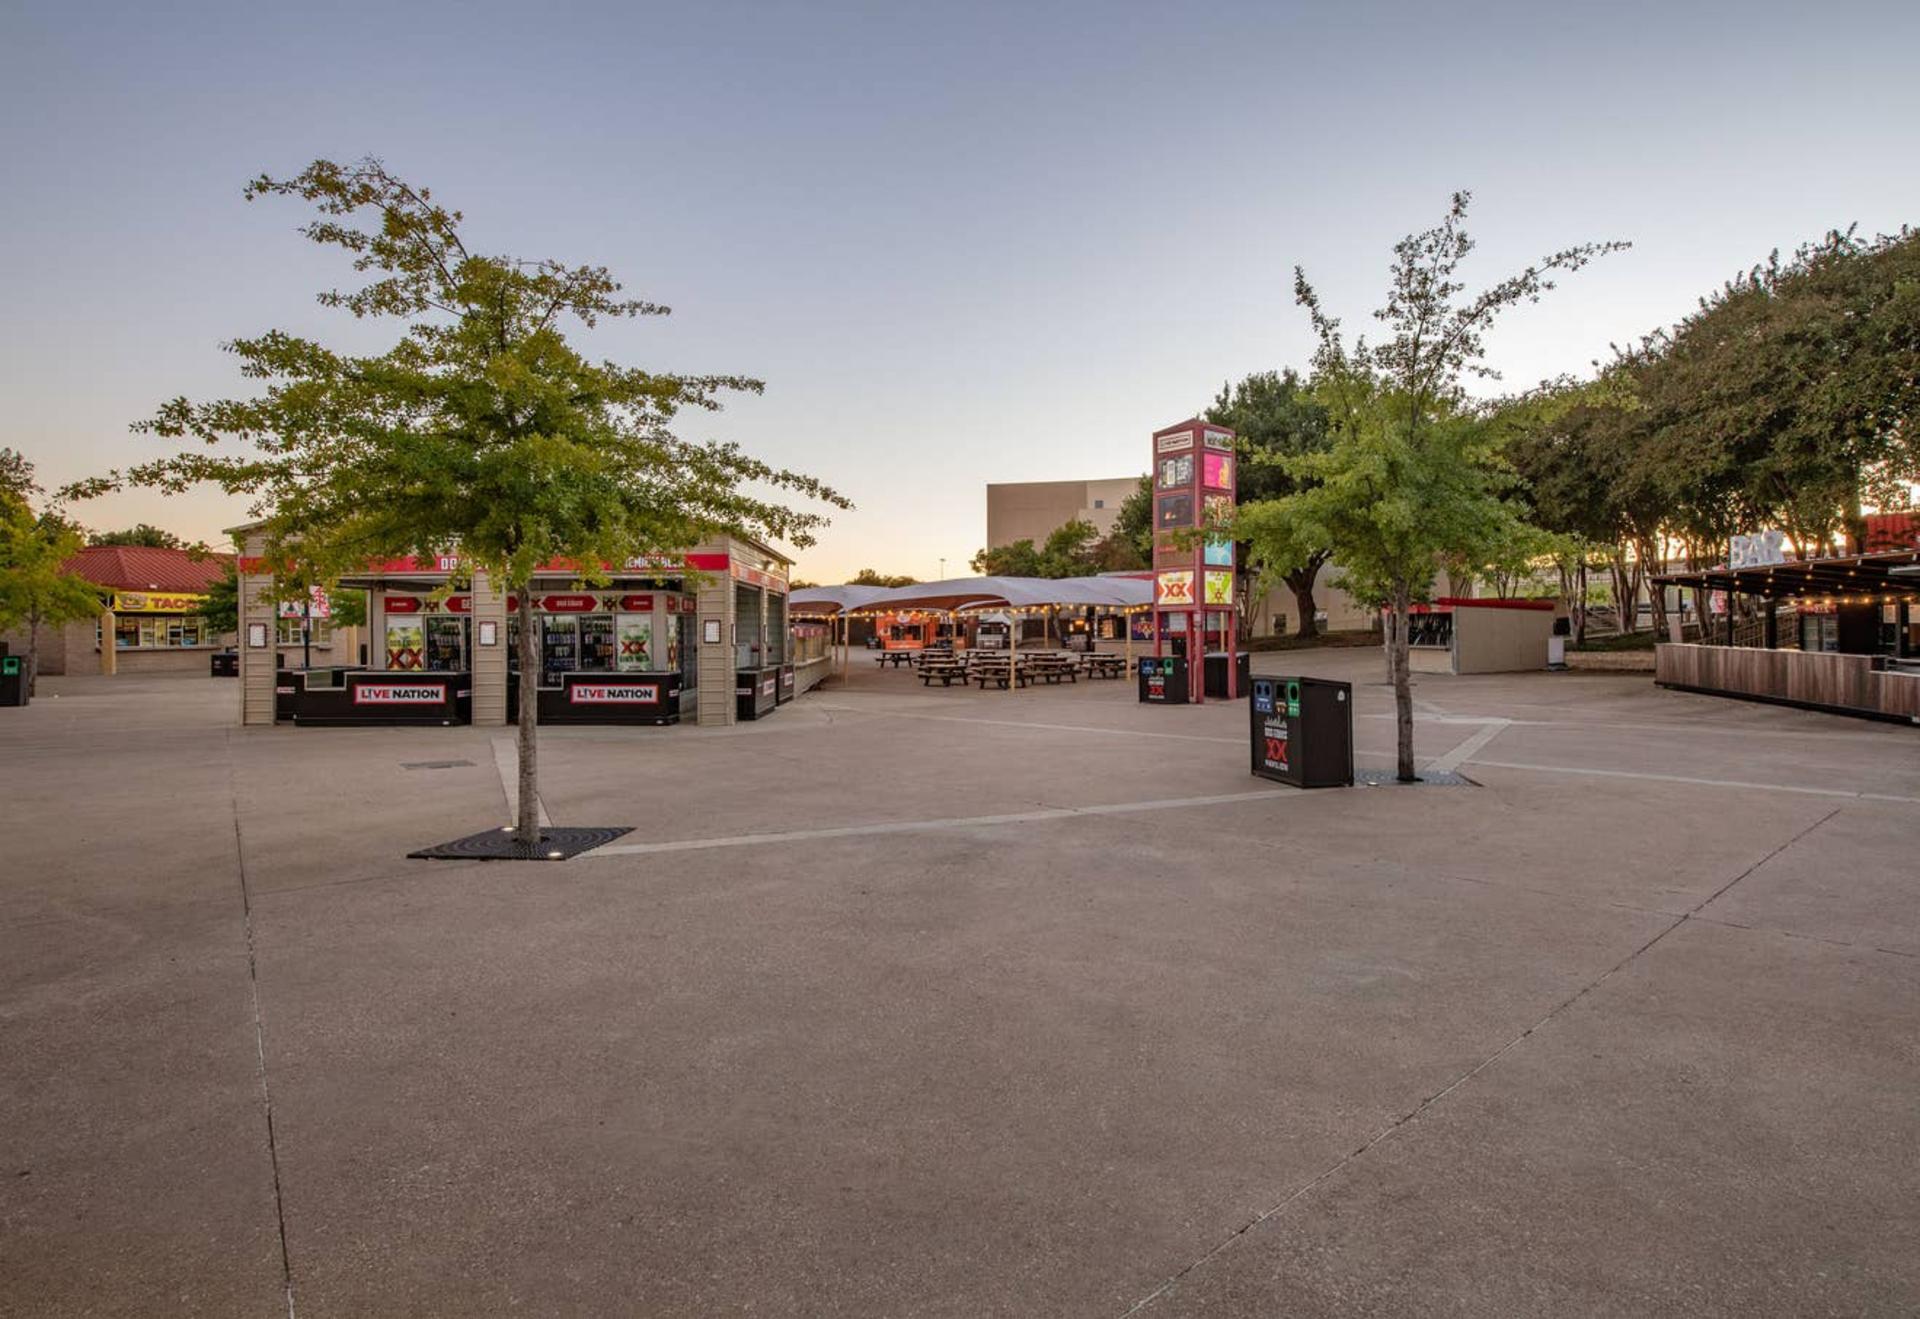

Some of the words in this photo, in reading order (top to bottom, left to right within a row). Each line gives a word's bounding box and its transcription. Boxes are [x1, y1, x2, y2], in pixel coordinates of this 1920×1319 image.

[1164, 583, 1186, 597] XX
[621, 641, 647, 655] XX
[388, 648, 423, 669] XX
[361, 688, 390, 699] LIVE
[392, 689, 440, 699] NATION
[577, 688, 605, 699] LIVE
[607, 688, 653, 698] NATION
[1266, 738, 1288, 764] XX
